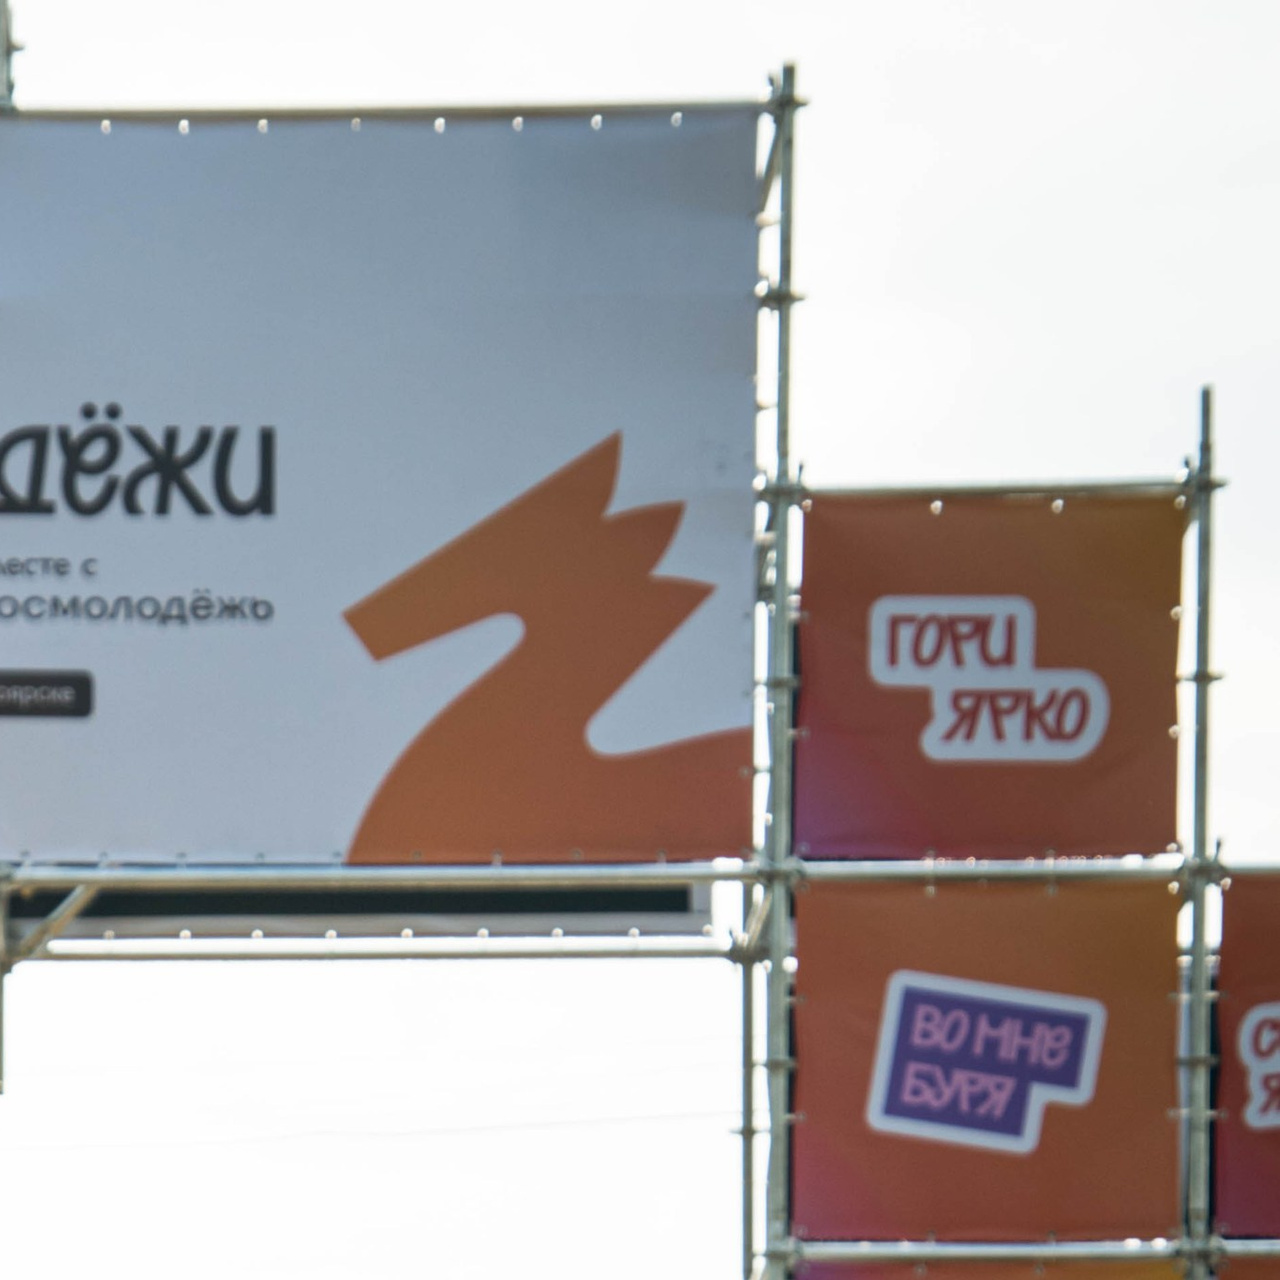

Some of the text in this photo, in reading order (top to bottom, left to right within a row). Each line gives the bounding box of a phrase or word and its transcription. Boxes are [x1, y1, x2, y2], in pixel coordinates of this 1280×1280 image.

[81, 557, 98, 577] с
[888, 614, 1017, 667] ГОРИ
[941, 689, 1090, 742] ЯРКО
[911, 1004, 970, 1054] ВО
[902, 1062, 1017, 1119] БУРЯ
